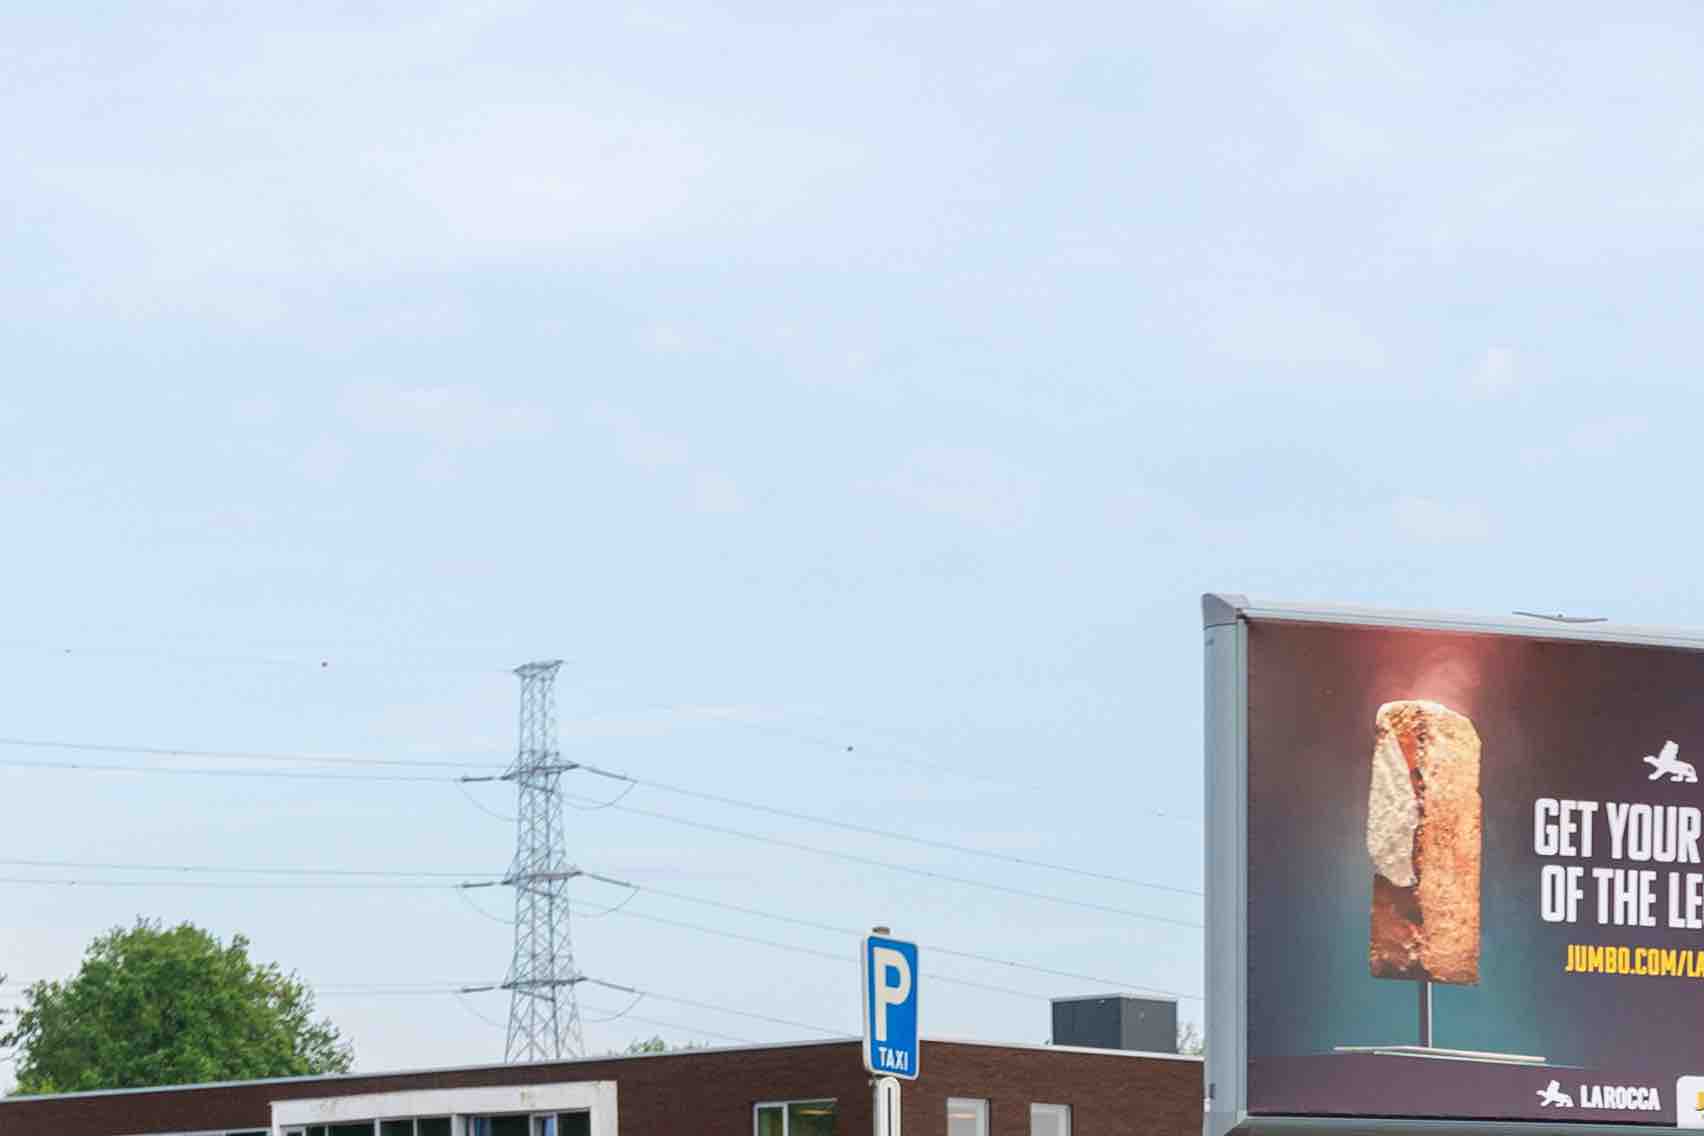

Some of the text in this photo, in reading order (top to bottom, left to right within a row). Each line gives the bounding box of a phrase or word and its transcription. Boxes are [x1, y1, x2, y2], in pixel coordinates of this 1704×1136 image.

[1534, 797, 1597, 857] GET
[1606, 802, 1702, 864] YOUR
[1540, 864, 1584, 923] OF
[1592, 869, 1656, 927] THE
[873, 946, 912, 1042] P
[877, 1046, 909, 1071] TAXI
[1580, 1084, 1661, 1111] LAROCCA
